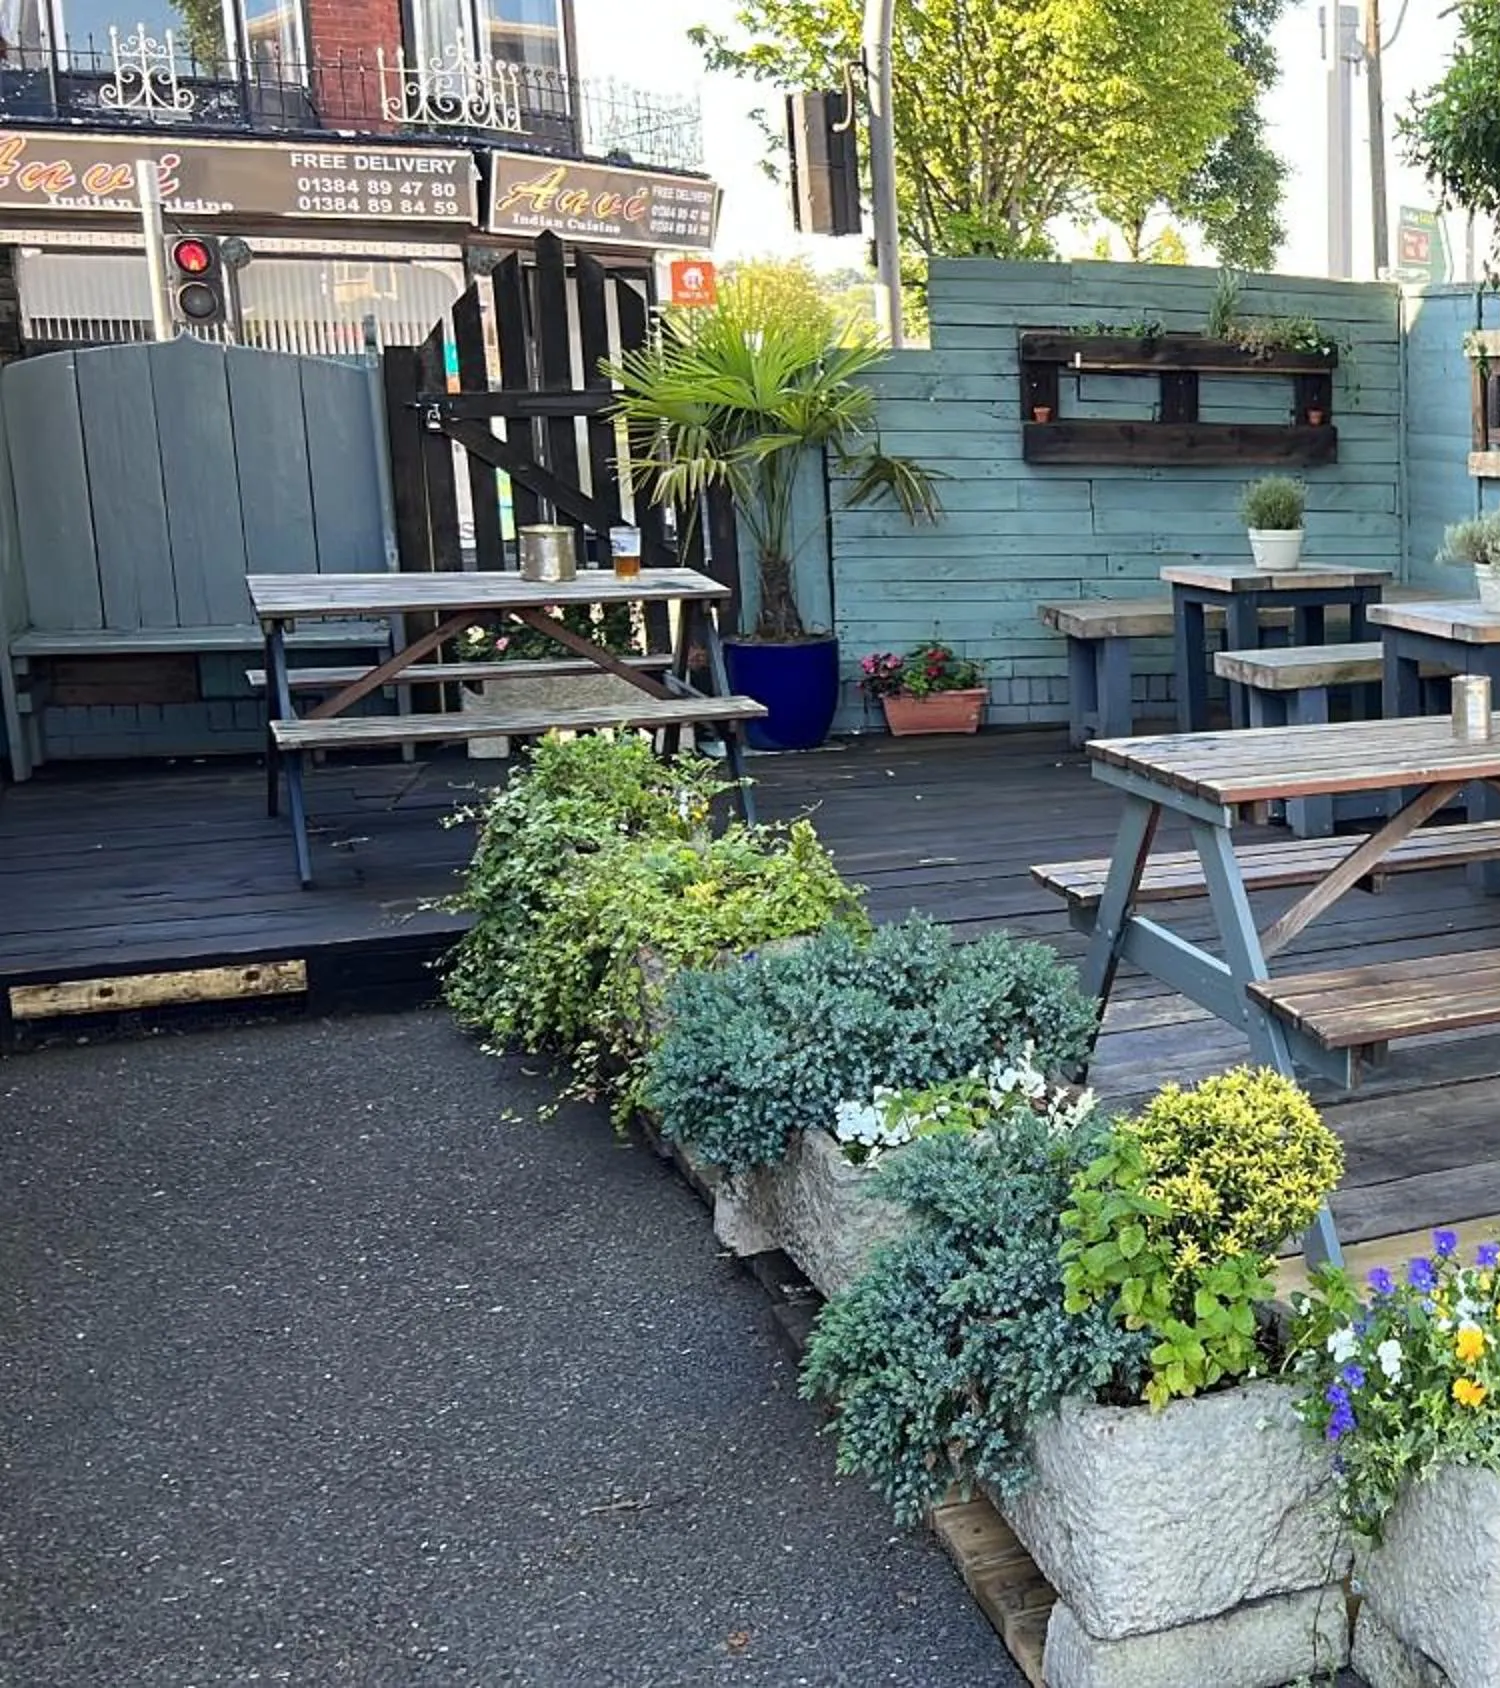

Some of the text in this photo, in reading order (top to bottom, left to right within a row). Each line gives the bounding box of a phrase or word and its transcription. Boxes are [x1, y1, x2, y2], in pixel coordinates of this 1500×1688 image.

[290, 153, 456, 174] FREE DELIVERY
[297, 177, 456, 197] 01384 89 47 80
[48, 194, 233, 211] Indian uisine
[299, 196, 459, 215] 01384 89 84 59
[512, 212, 621, 234] Indian Cuisine
